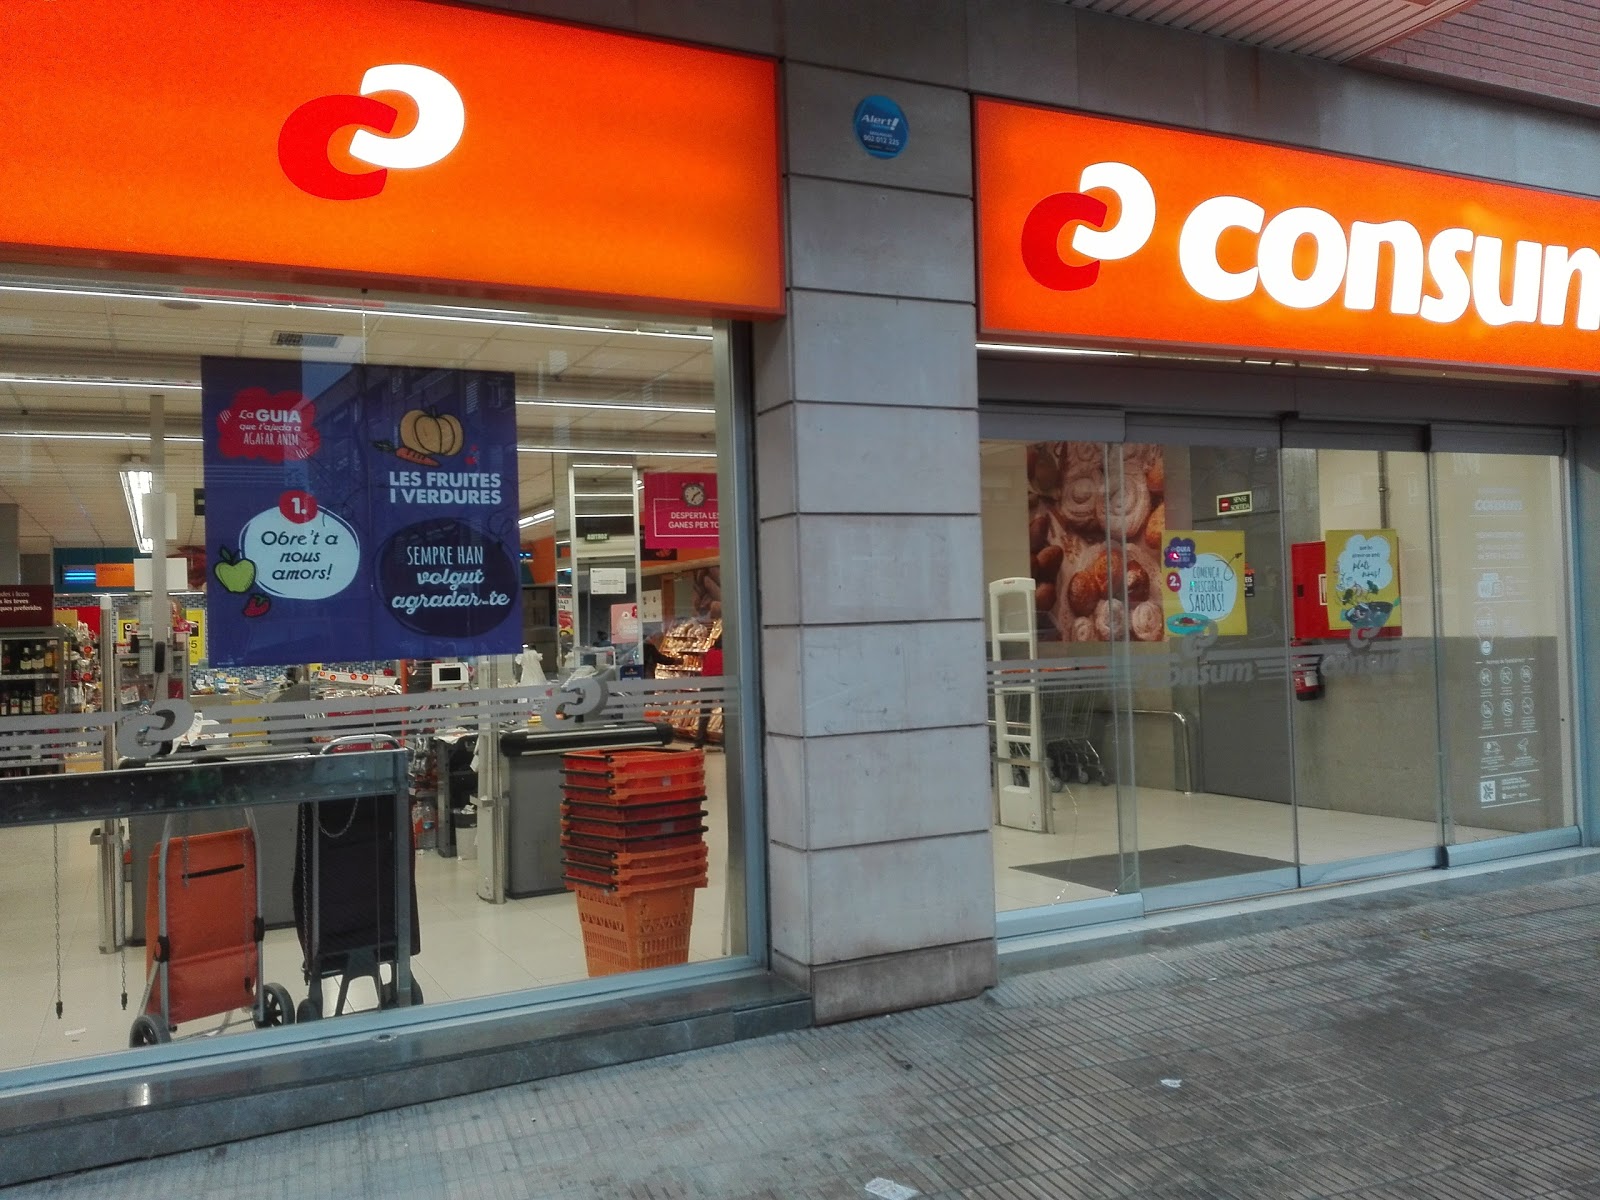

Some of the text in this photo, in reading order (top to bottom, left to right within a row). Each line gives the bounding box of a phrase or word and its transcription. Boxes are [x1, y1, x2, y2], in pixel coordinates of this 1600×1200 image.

[861, 114, 899, 131] Alert!
[863, 134, 875, 142] 902
[239, 408, 302, 423] La GUIA
[240, 423, 256, 431] que
[389, 471, 501, 488] LES FRUITES
[390, 488, 502, 505] I VERDURES
[291, 497, 307, 515] 1.
[670, 511, 707, 519] DESPERTA
[261, 529, 338, 546] Obre't a
[280, 552, 321, 563] nous
[407, 546, 483, 565] SEMPRE HAN
[272, 563, 333, 580] amors!
[416, 568, 485, 591] volgut
[1193, 567, 1220, 579] COMENÇA
[391, 591, 510, 615] agradar-te
[1189, 593, 1225, 612] SABORS!
